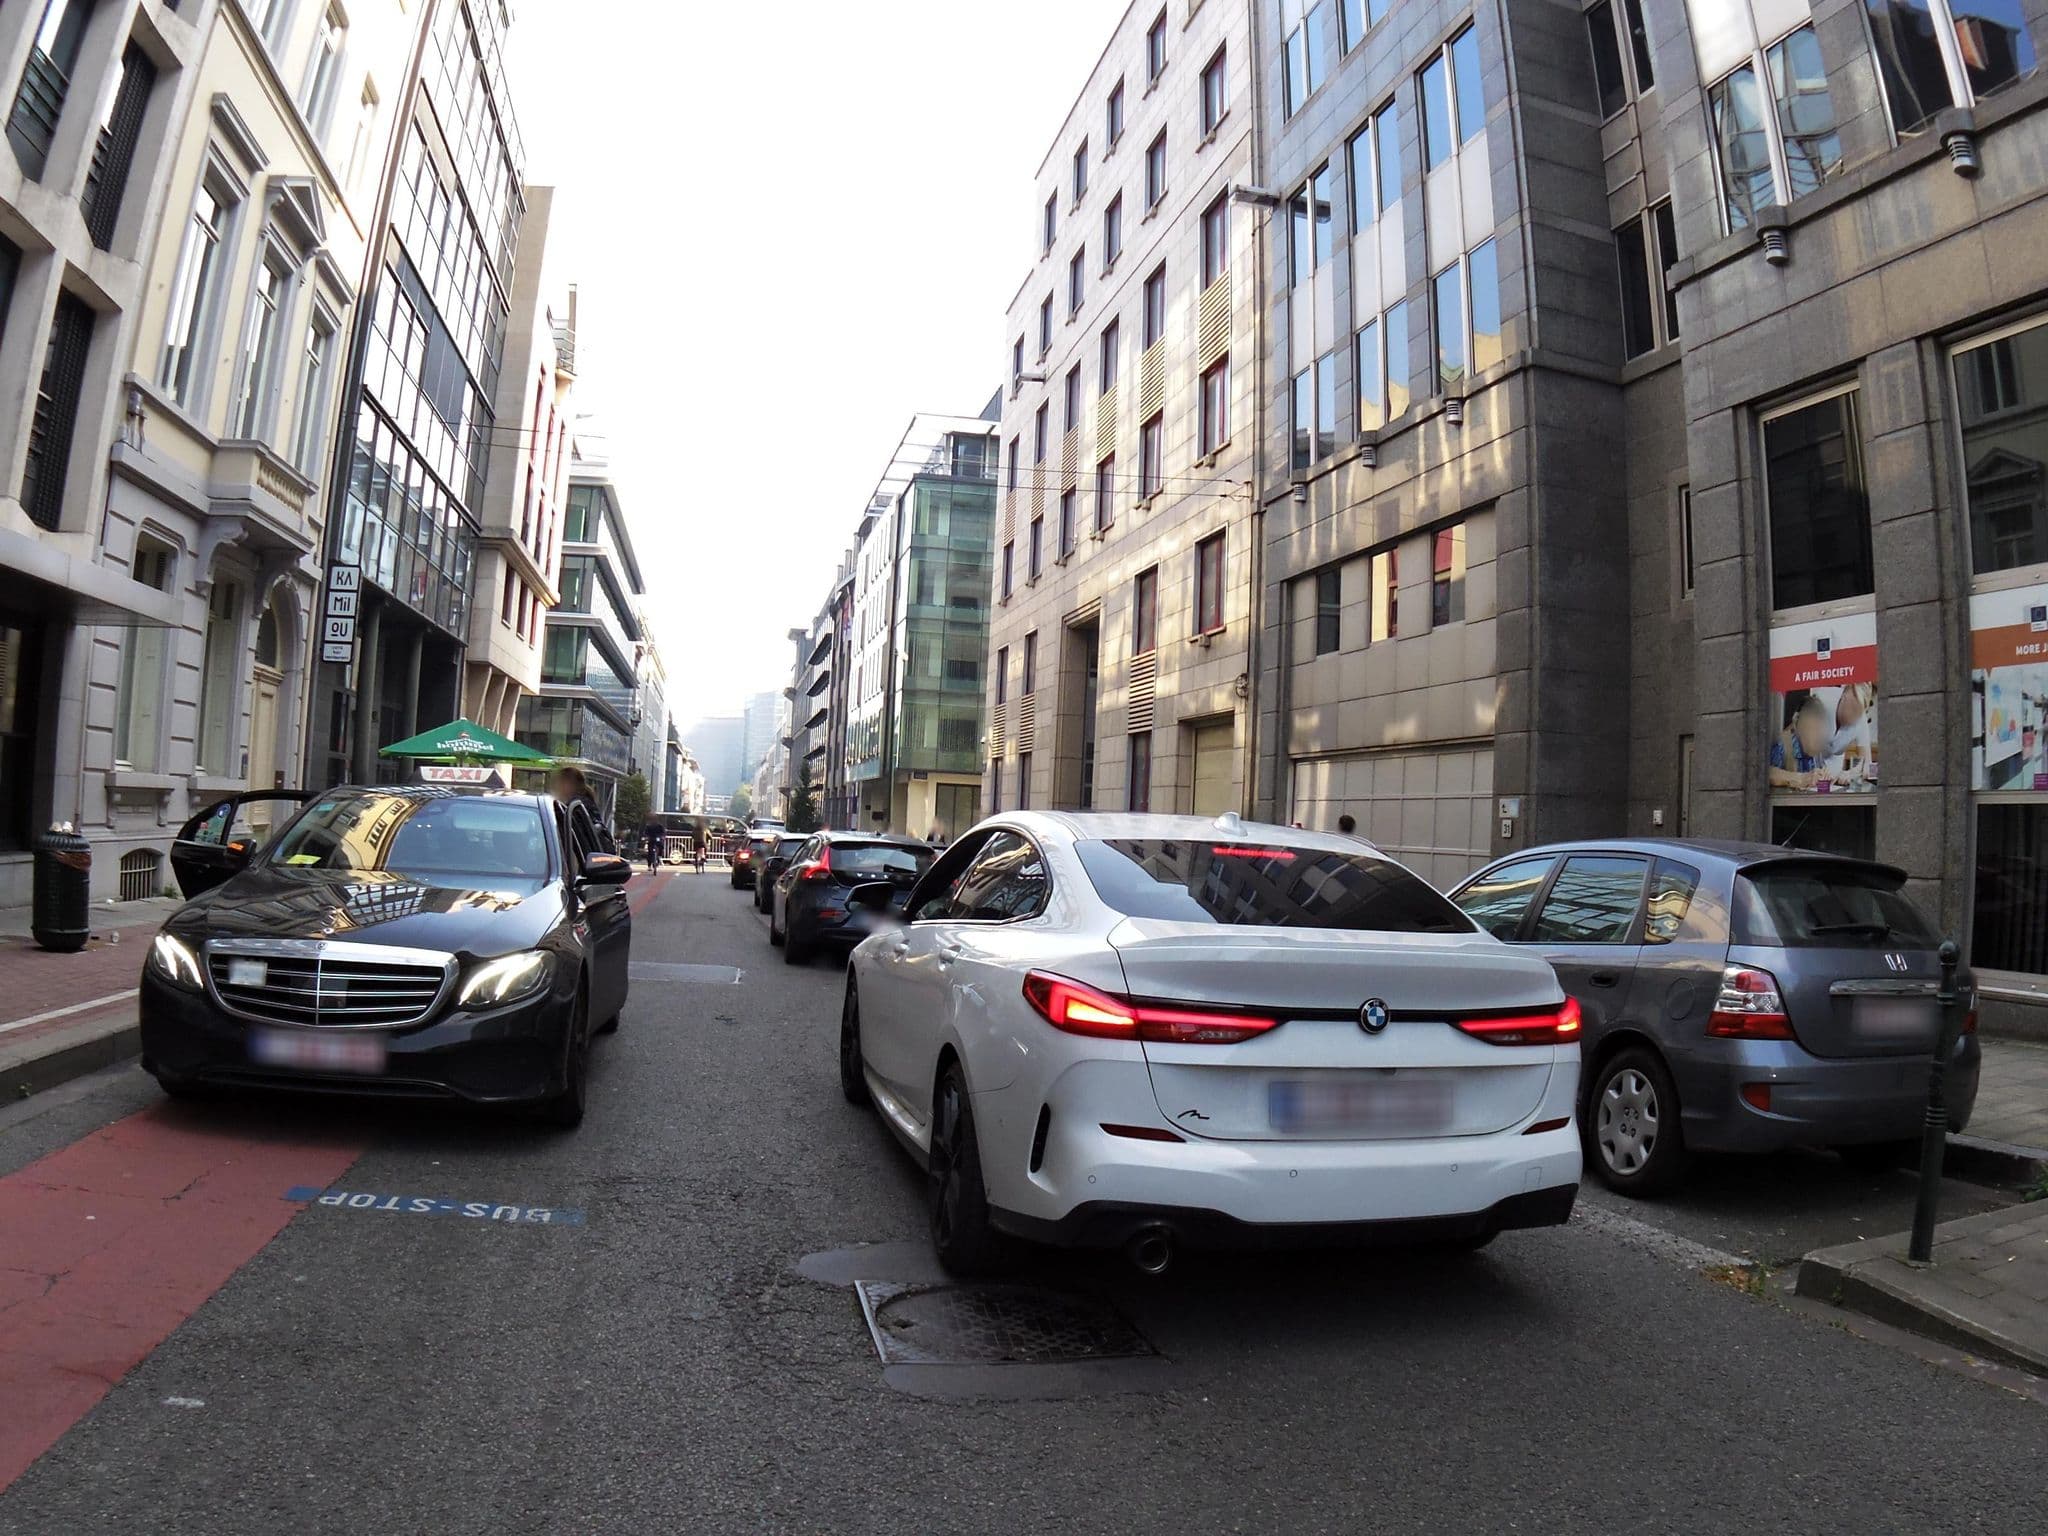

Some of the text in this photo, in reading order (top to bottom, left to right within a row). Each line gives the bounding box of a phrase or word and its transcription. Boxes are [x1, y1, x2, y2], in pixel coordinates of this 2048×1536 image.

[2015, 643, 2041, 656] MORE
[1794, 666, 1854, 682] A FAIR SOCIETY
[429, 768, 482, 780] TAXI
[319, 1192, 551, 1222] BUS-STOP
